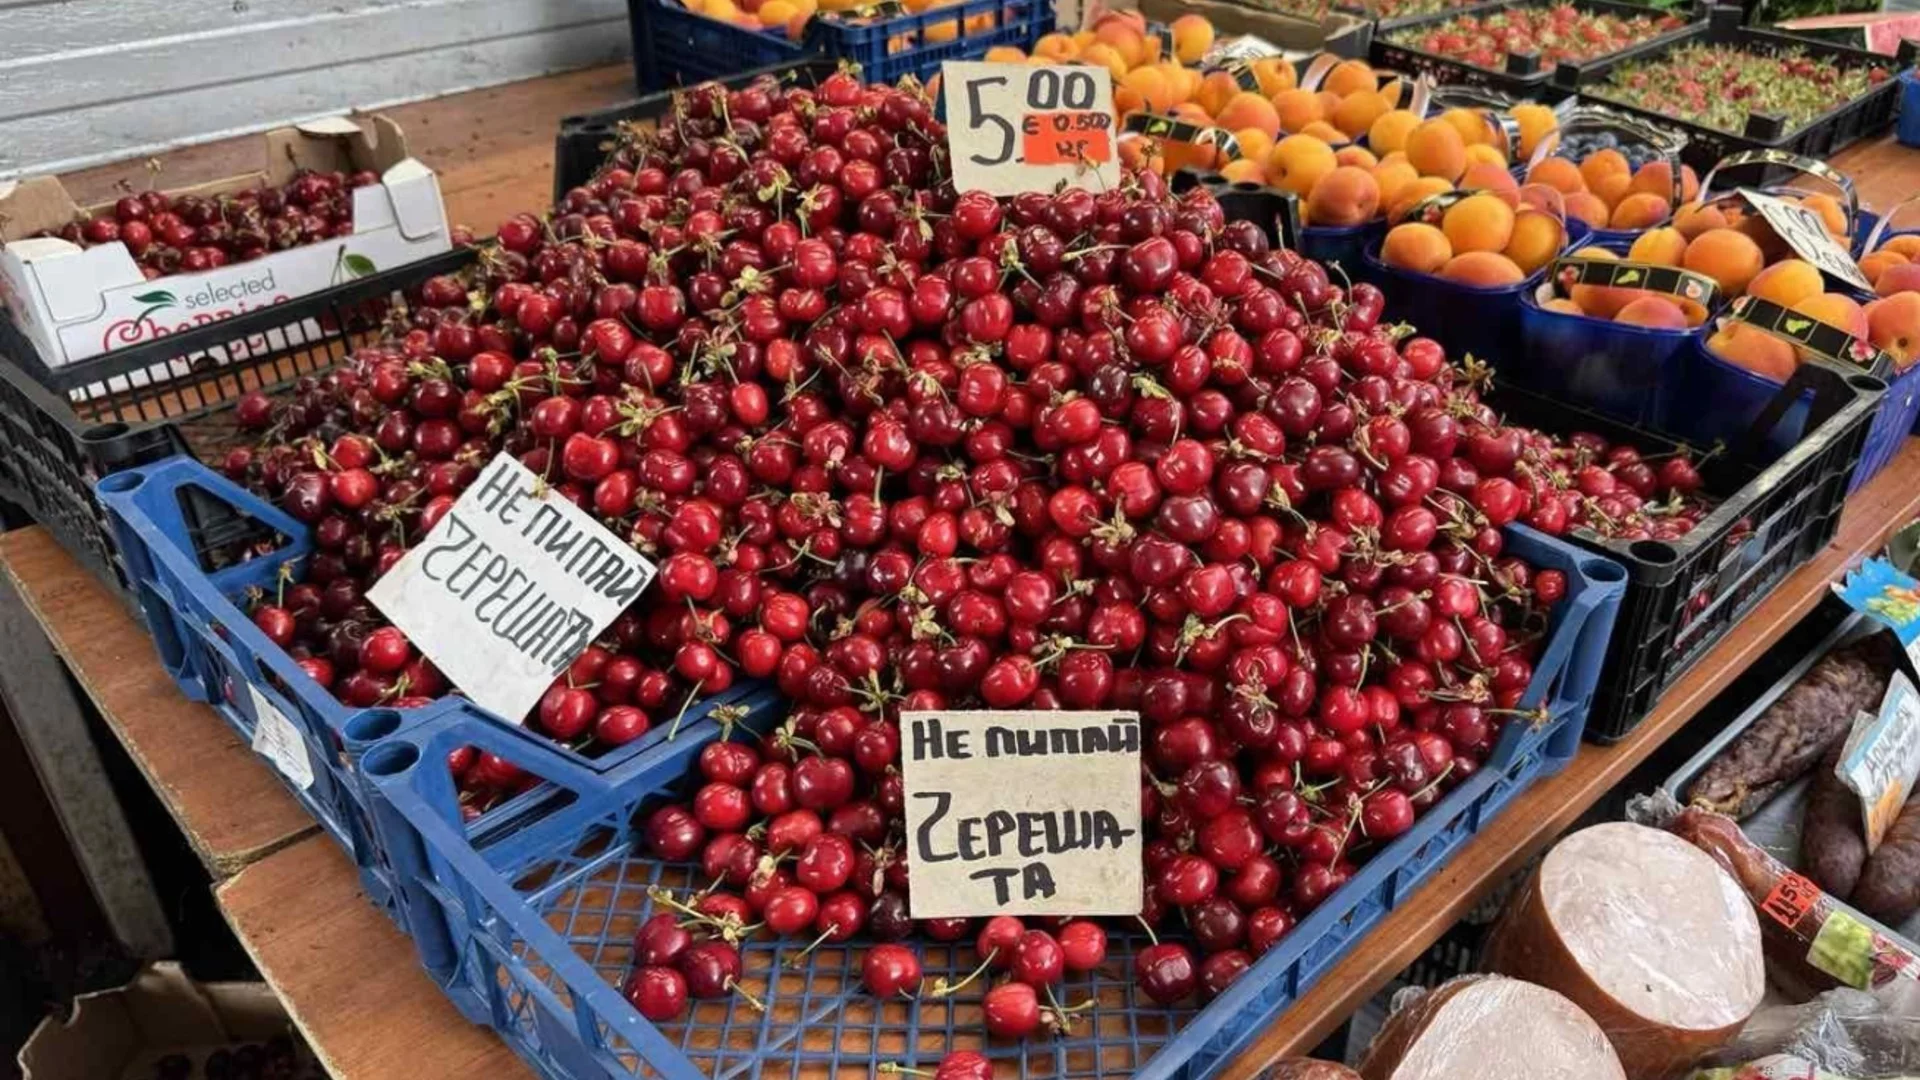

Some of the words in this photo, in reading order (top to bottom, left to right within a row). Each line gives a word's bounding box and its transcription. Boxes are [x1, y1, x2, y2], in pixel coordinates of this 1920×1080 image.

[185, 268, 276, 310] selected
[476, 463, 531, 525] НЕ
[521, 504, 648, 607] ПИПАЙ
[969, 861, 1057, 906] ТА
